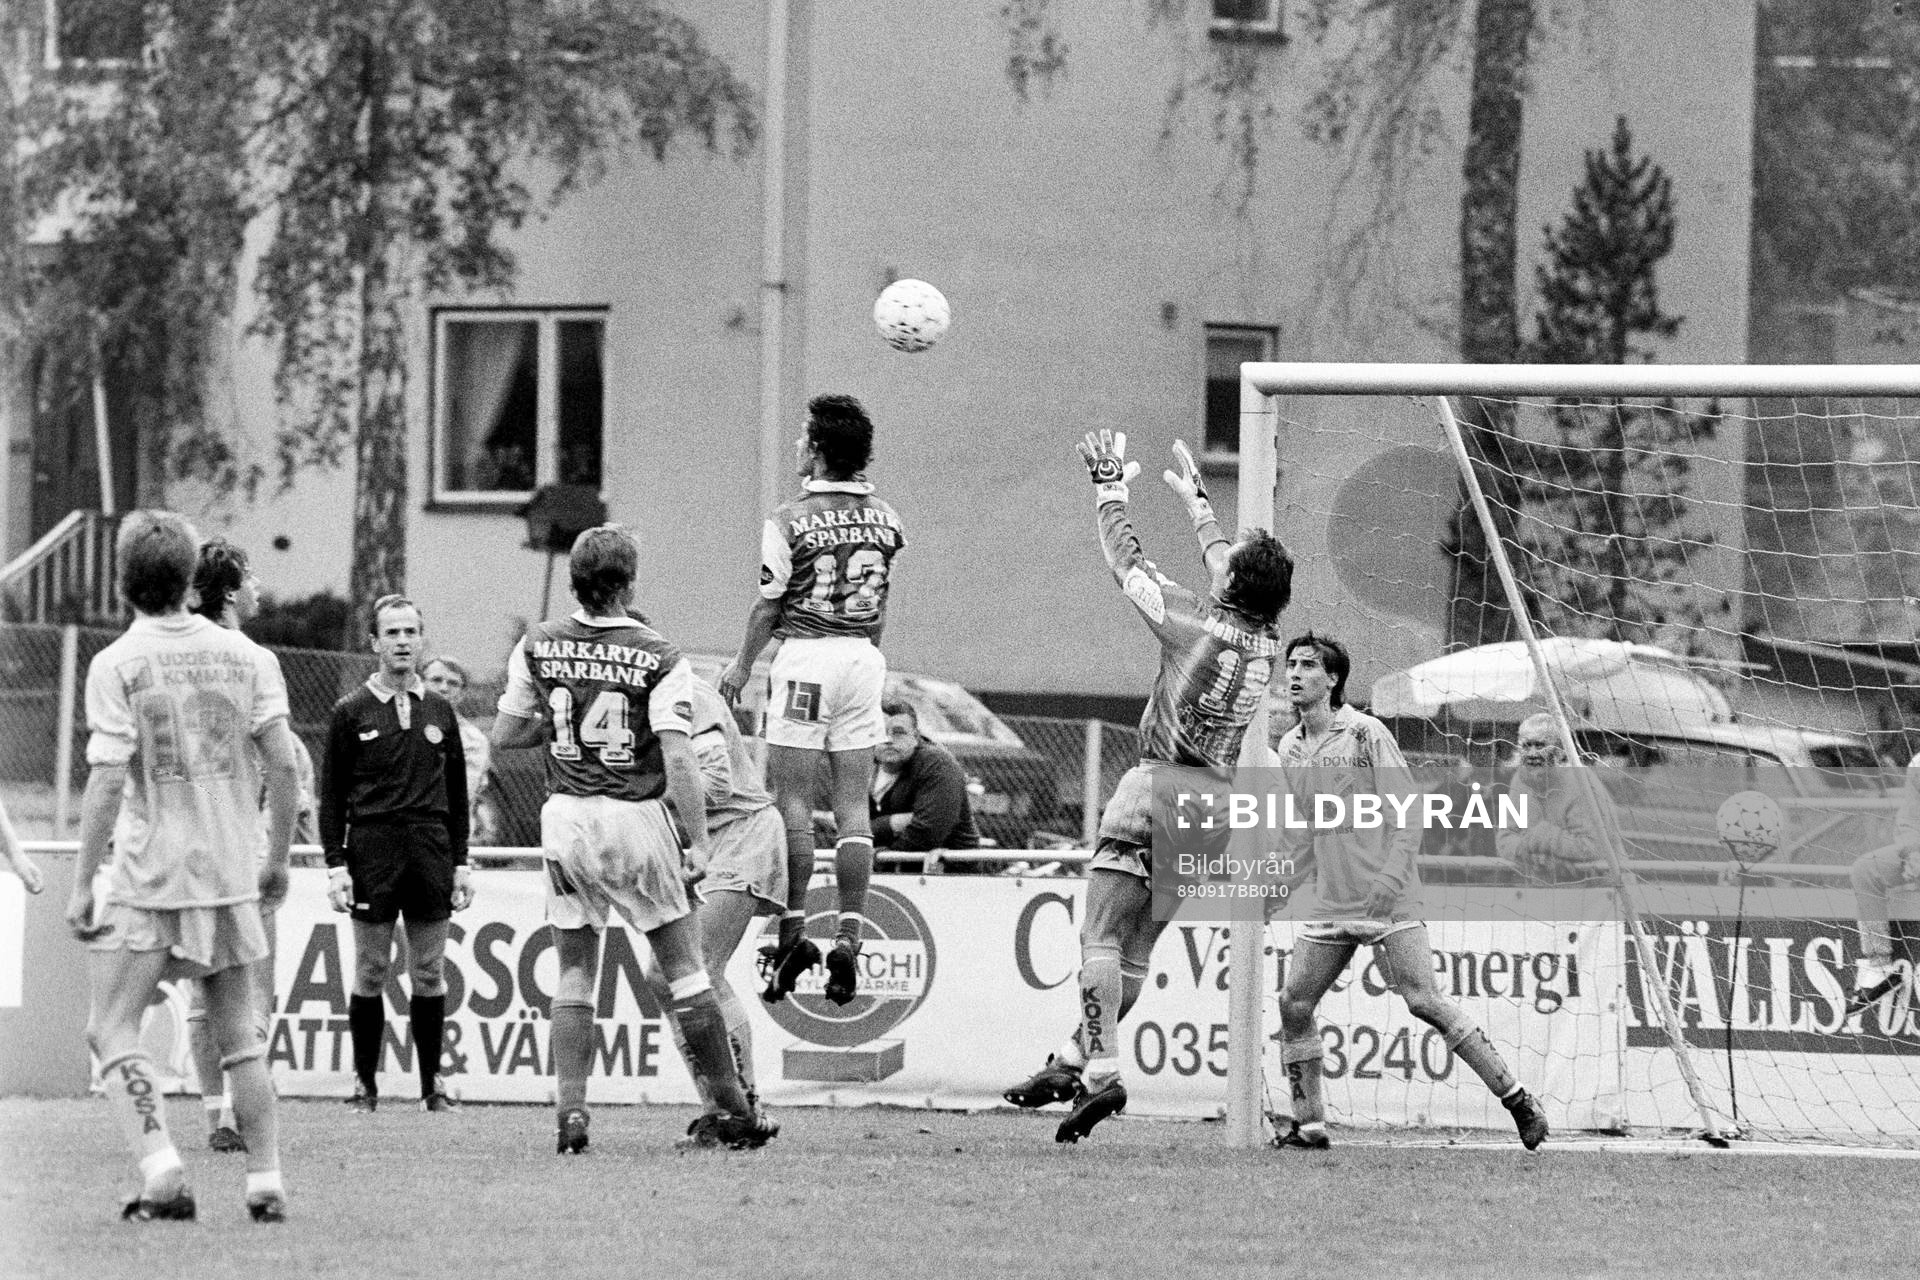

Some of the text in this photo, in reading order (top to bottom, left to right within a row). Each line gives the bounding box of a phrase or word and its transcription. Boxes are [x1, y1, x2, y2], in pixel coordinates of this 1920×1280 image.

[533, 640, 661, 670] MARKARYDS
[541, 660, 648, 688] SPARBANK
[549, 687, 635, 766] 14
[477, 1009, 661, 1077] VÄME
[1083, 987, 1104, 1053] KOSA
[120, 1063, 161, 1135] KOSA
